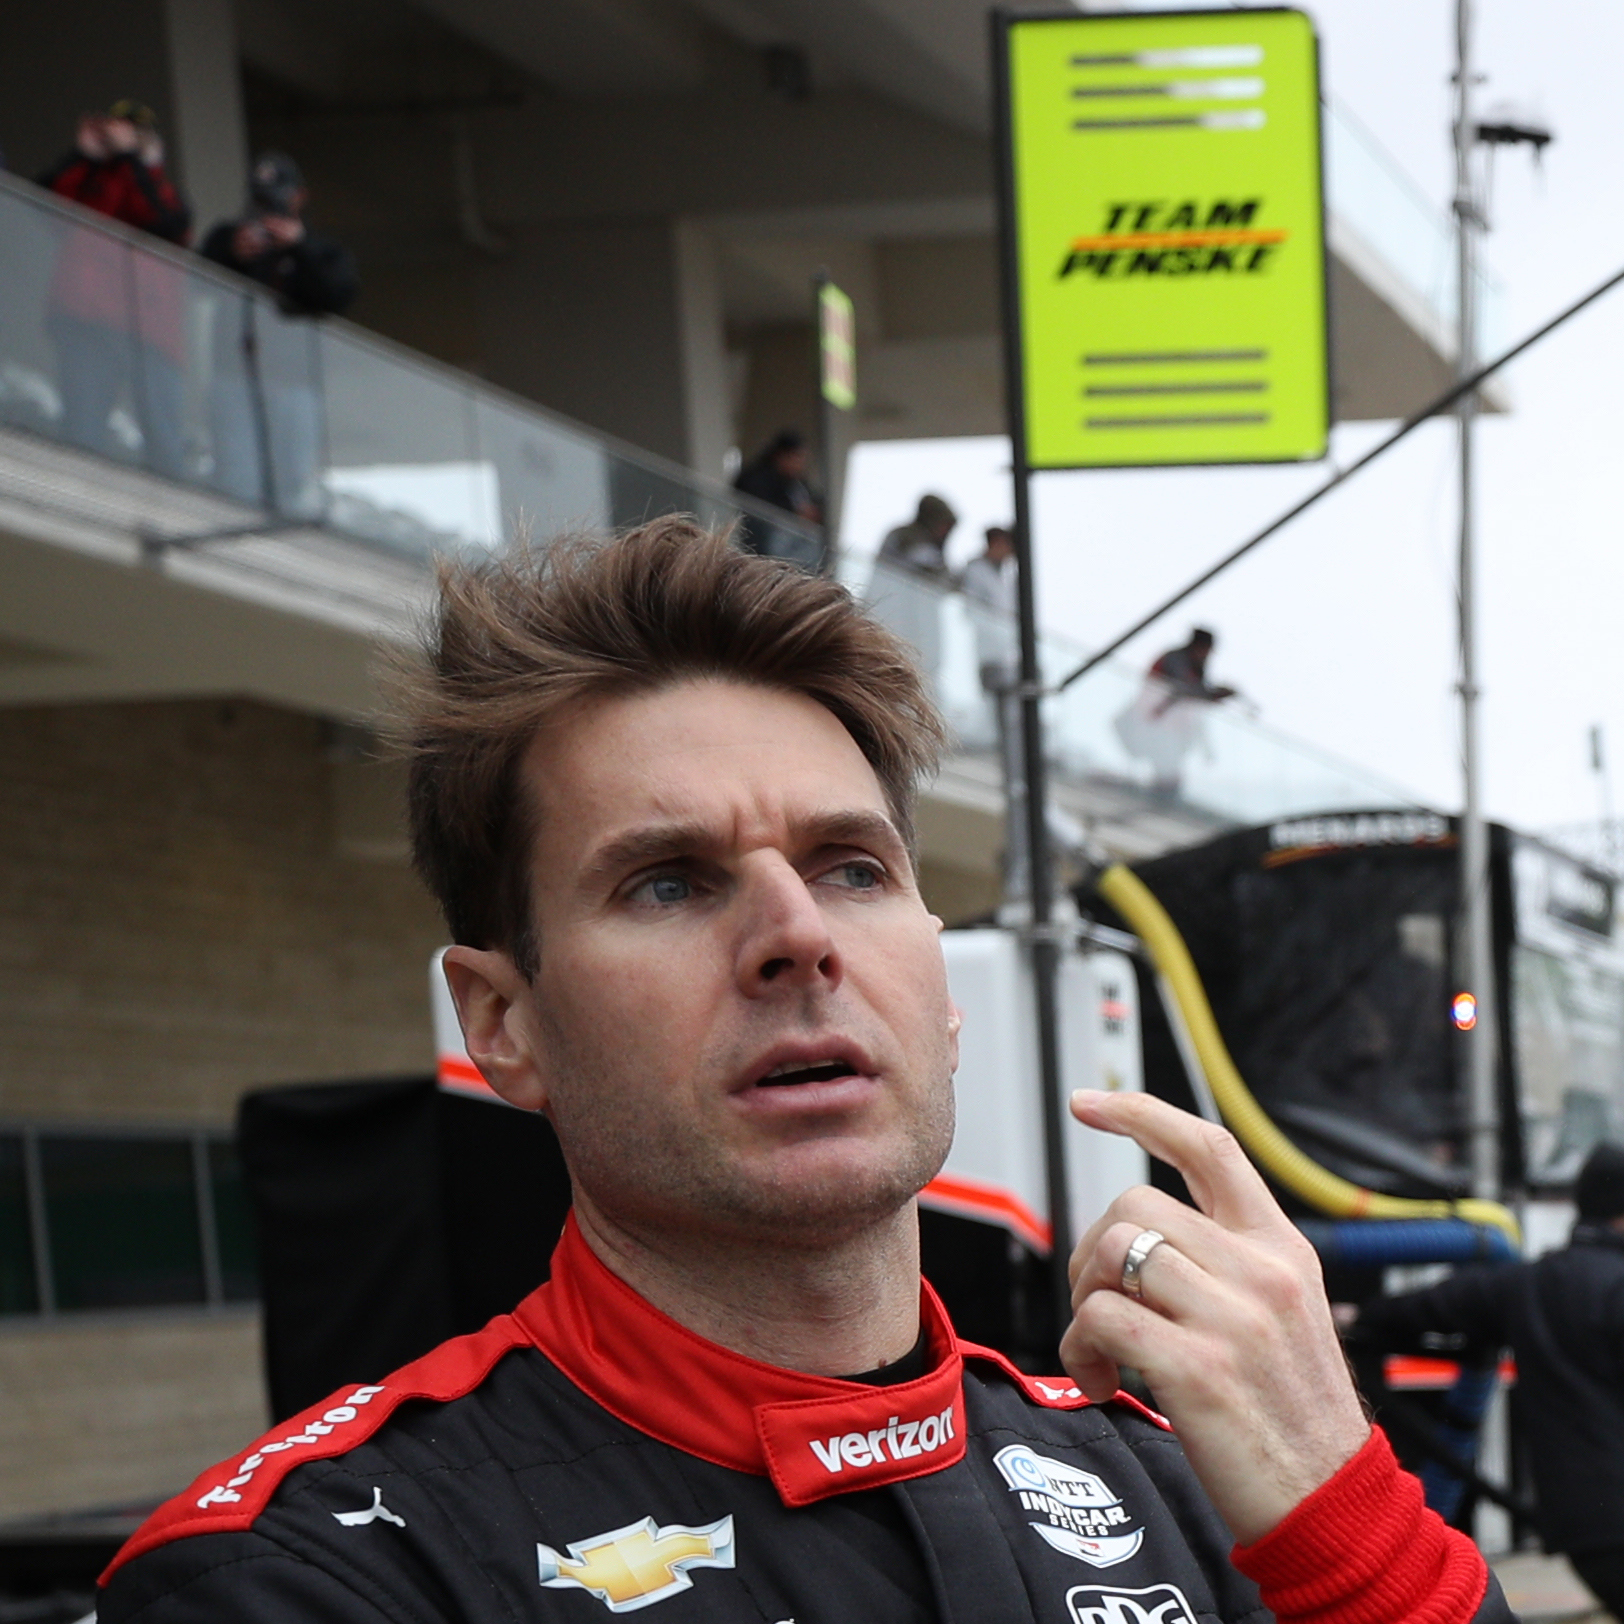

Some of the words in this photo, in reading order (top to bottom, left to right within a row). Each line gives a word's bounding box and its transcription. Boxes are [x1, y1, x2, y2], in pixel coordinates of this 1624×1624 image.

[1104, 199, 1262, 231] TEAM
[1056, 247, 1279, 280] PENSKE
[808, 1405, 956, 1473] verizon
[1045, 1475, 1095, 1497] NTT
[1018, 1491, 1131, 1527] INDYCAR
